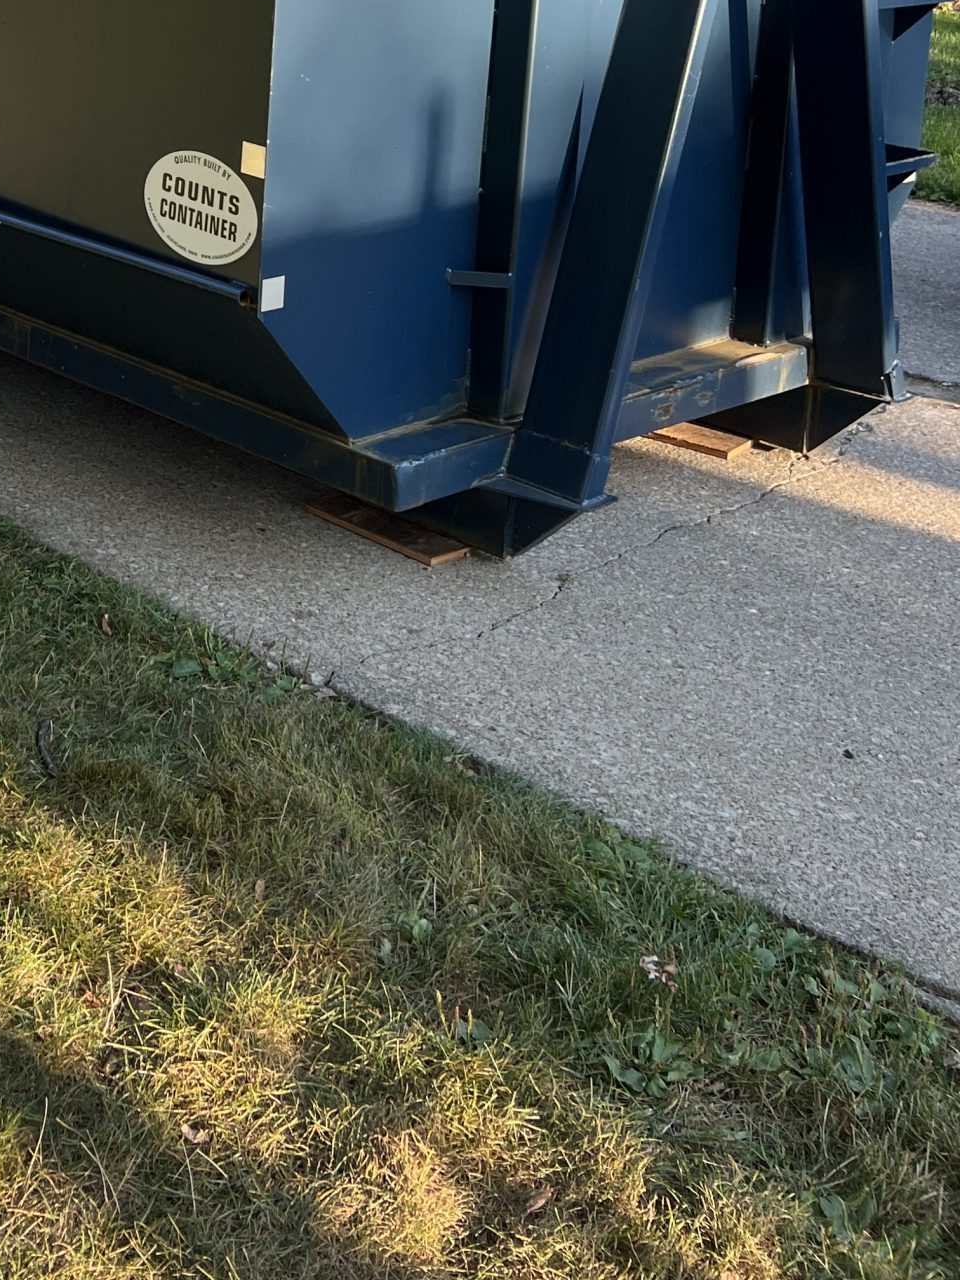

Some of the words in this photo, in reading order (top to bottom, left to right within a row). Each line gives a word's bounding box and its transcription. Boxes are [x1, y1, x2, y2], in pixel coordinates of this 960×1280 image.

[174, 155, 202, 165] QUALITY
[203, 158, 221, 174] BUILT
[221, 170, 232, 181] BY
[161, 172, 240, 216] COUNTS
[160, 198, 238, 243] CONTAINER
